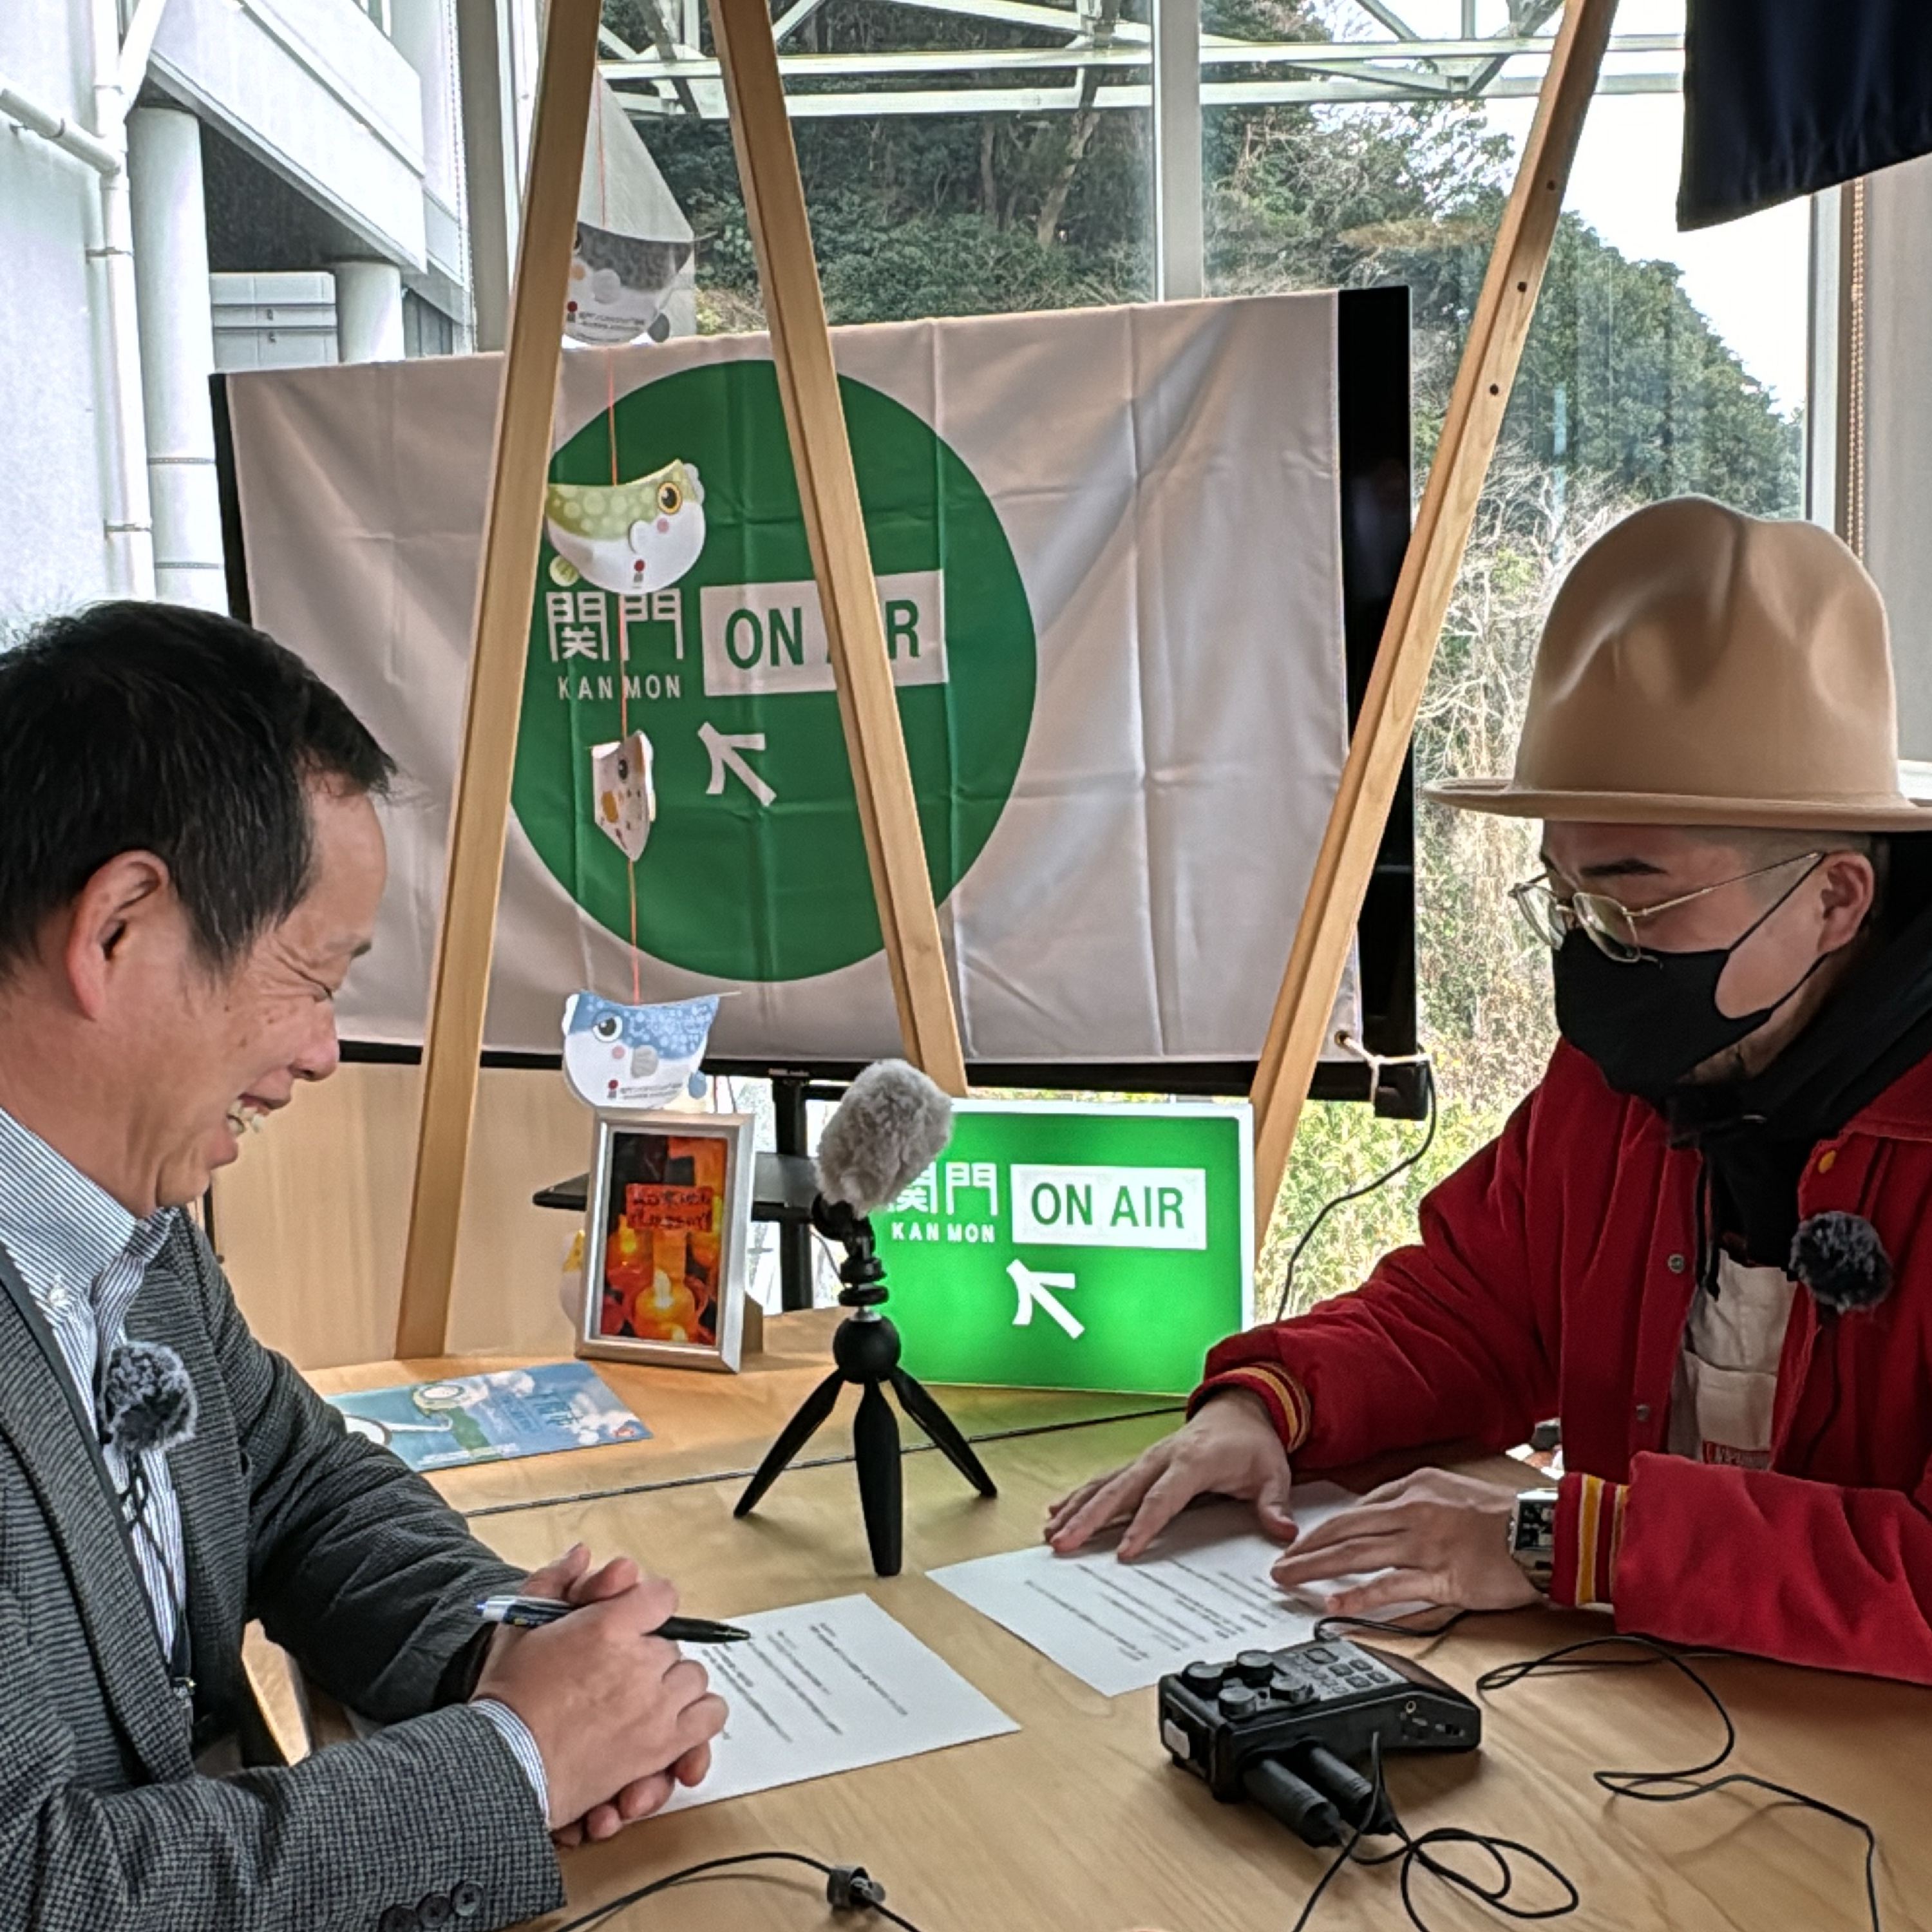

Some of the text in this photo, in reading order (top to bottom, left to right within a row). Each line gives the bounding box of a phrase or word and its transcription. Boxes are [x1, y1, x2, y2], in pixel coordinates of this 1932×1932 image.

[546, 588, 683, 663] 関門
[725, 607, 804, 670] ON
[1031, 1182, 1185, 1229] ON AIR
